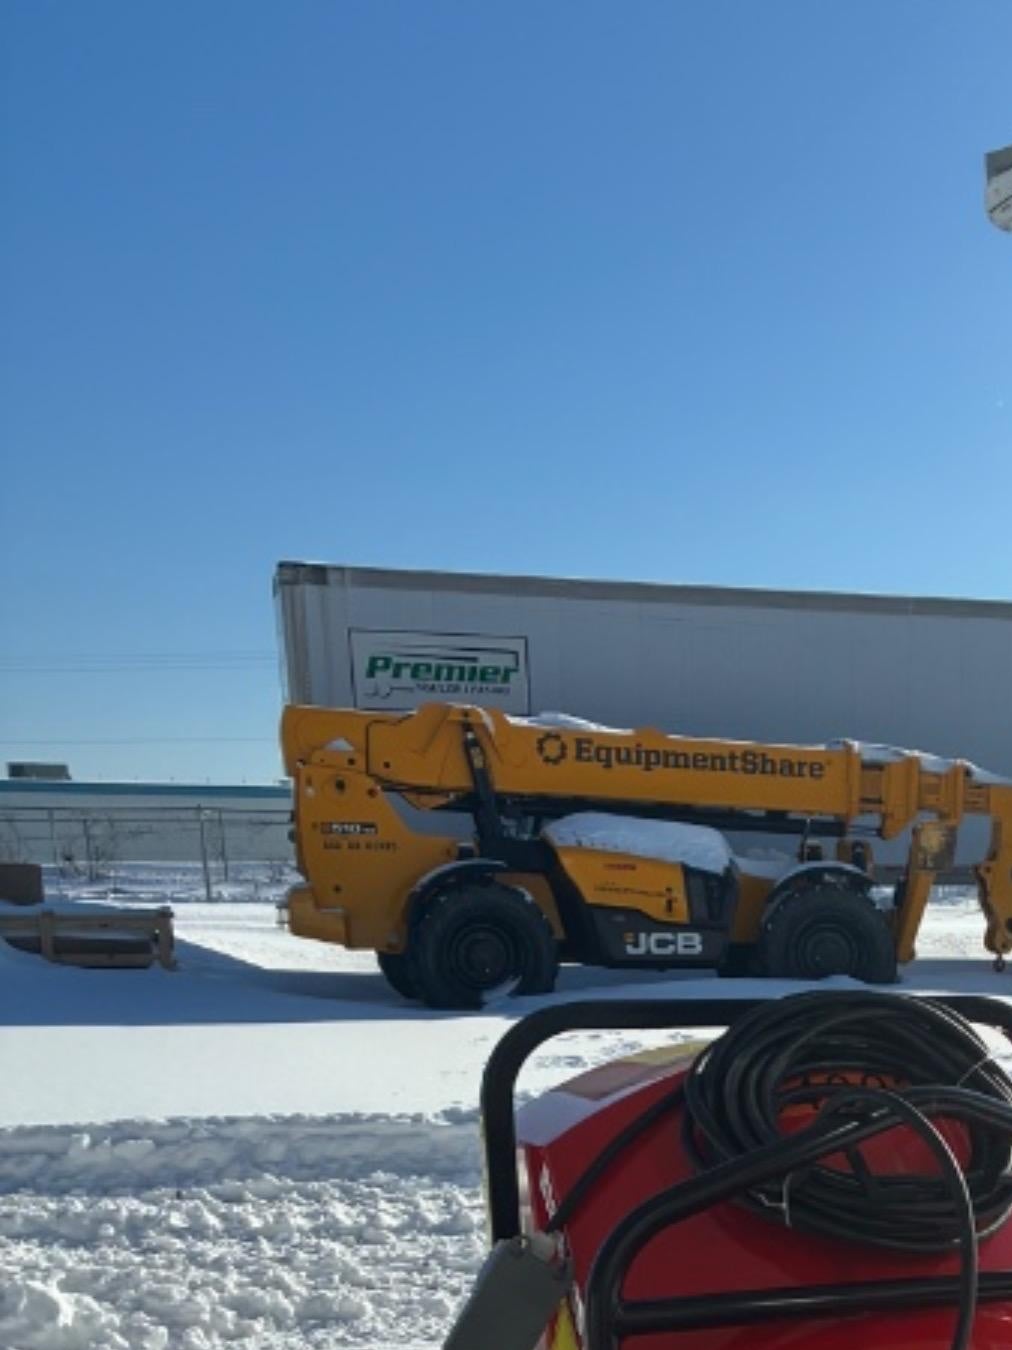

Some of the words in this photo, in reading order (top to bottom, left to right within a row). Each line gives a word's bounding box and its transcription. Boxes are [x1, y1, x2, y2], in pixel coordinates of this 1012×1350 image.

[365, 656, 519, 684] Premier
[573, 737, 826, 779] EquipmentShare
[625, 932, 703, 955] JCB
